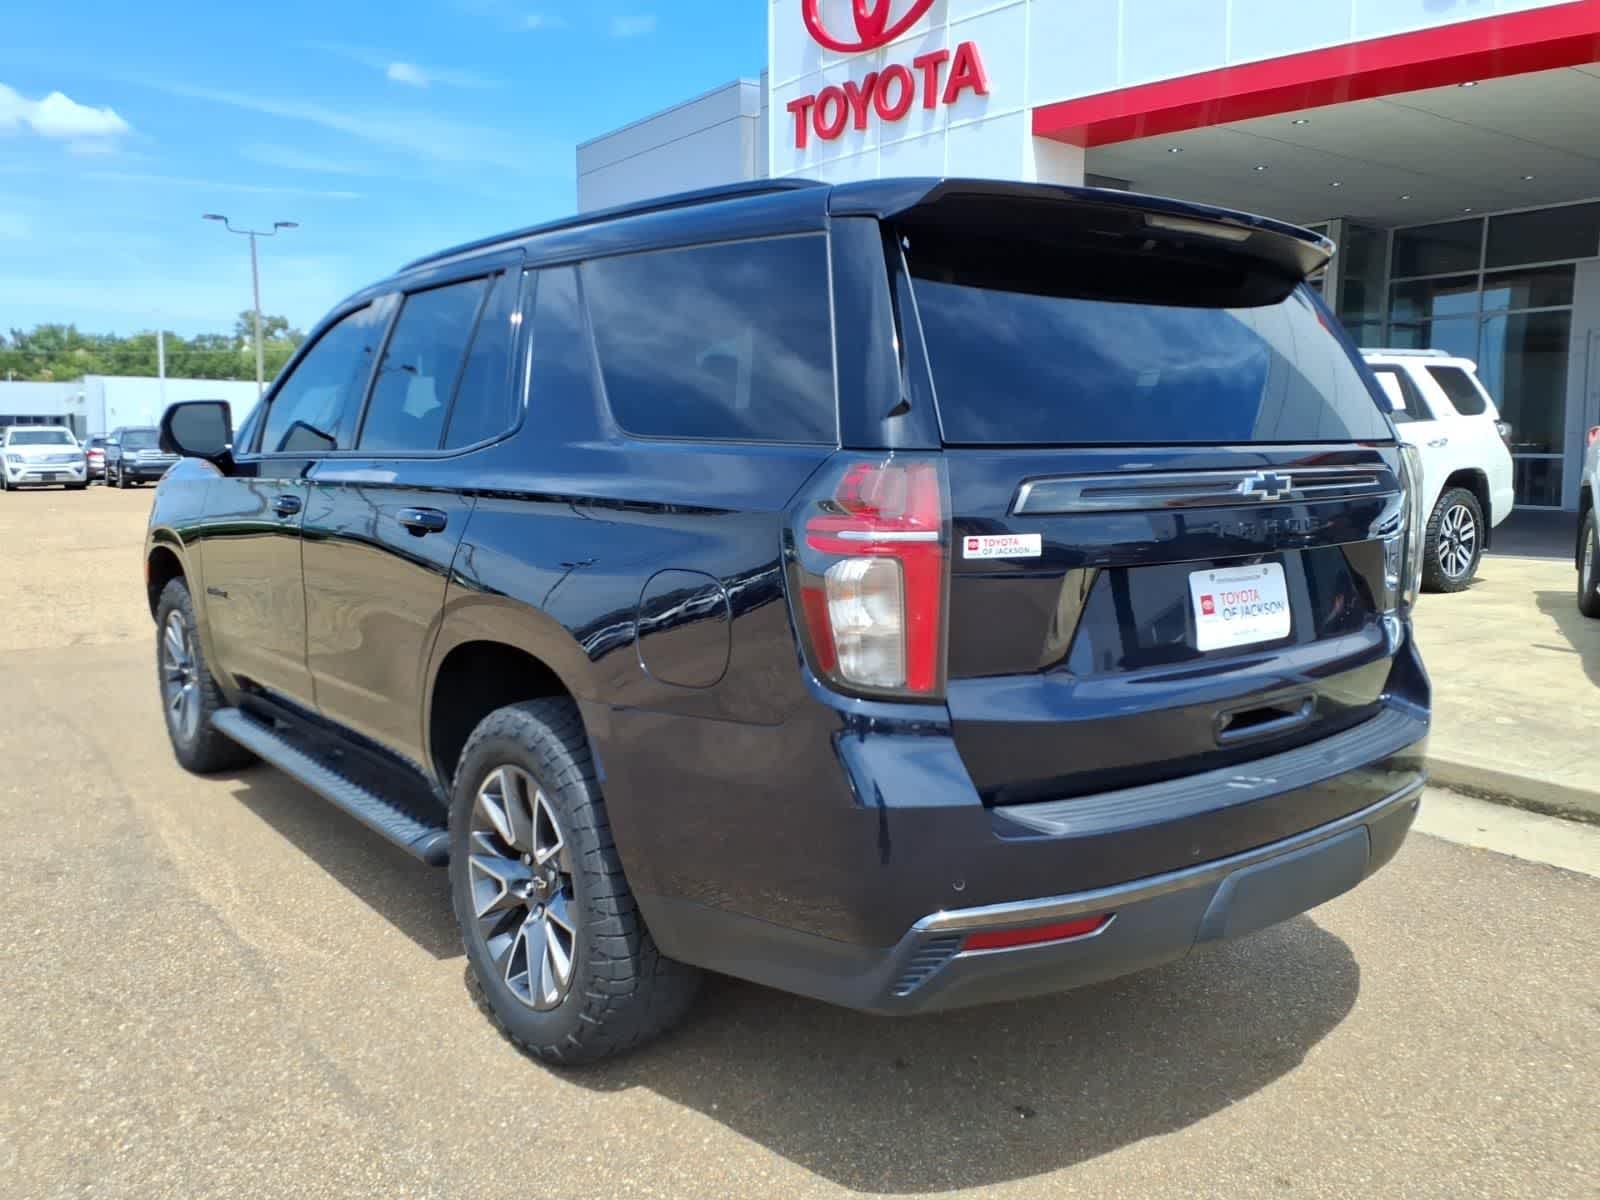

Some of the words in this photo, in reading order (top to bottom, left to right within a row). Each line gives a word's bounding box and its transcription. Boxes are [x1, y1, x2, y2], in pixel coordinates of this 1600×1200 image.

[787, 41, 988, 149] TOYOTA
[983, 538, 1019, 547] TOYOTA
[982, 548, 993, 556] OF
[995, 546, 1030, 555] JACKSON
[1220, 589, 1261, 605] TOYOTA
[1223, 607, 1237, 621] OF
[1240, 601, 1285, 620] JACKSON
